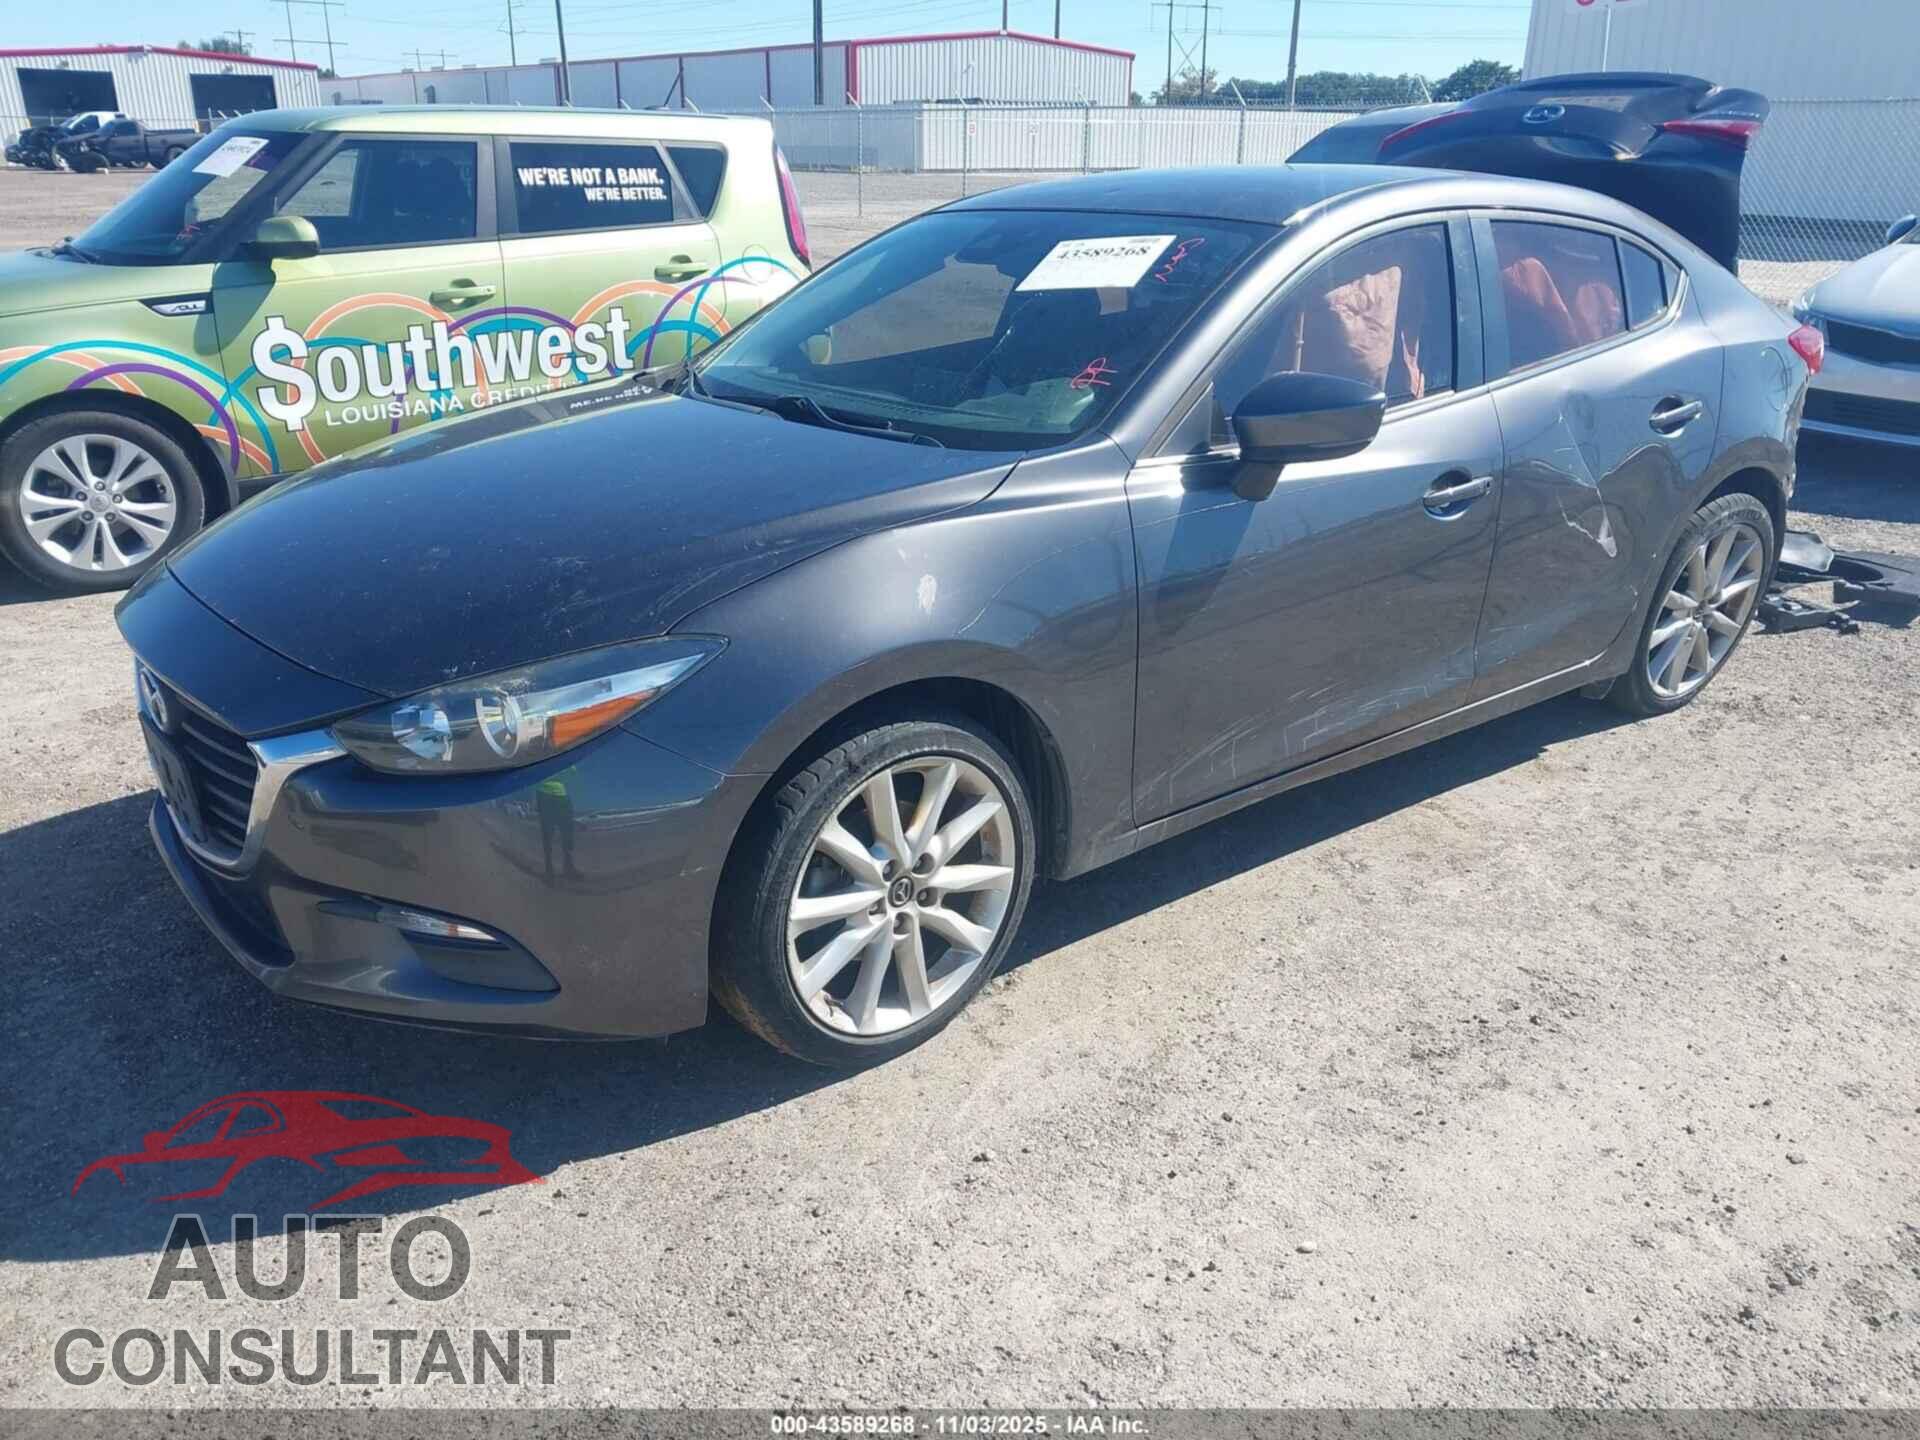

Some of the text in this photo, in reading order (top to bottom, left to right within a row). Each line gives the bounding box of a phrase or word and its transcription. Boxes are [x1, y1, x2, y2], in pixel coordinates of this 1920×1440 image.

[517, 167, 665, 186] WE'RE NOT A BANK.
[584, 187, 668, 201] WE'RE BETTER.
[1057, 246, 1151, 260] 43589268
[325, 396, 465, 427] LOUISIANA
